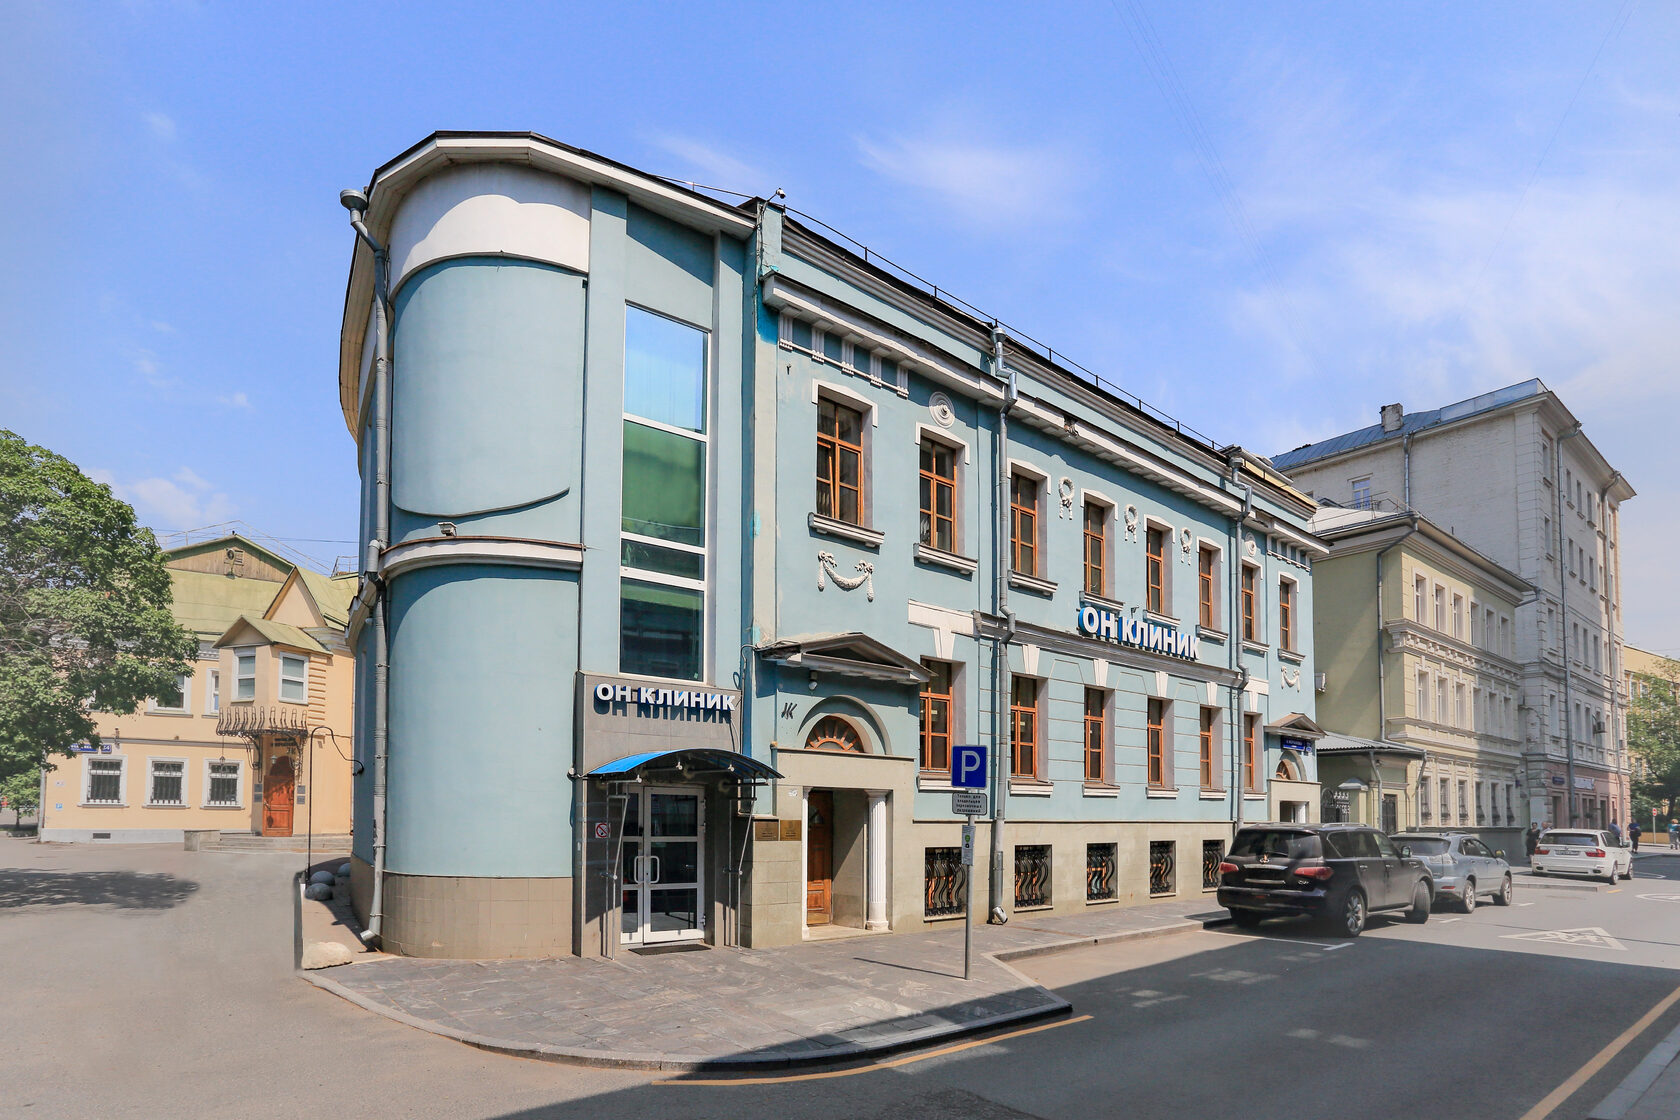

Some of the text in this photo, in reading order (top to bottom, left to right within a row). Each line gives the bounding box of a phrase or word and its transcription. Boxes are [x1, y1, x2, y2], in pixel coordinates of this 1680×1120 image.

[1080, 606, 1200, 660] ОН КЛИНИК
[595, 683, 736, 711] ОН КЛИНИК
[961, 750, 980, 783] P
